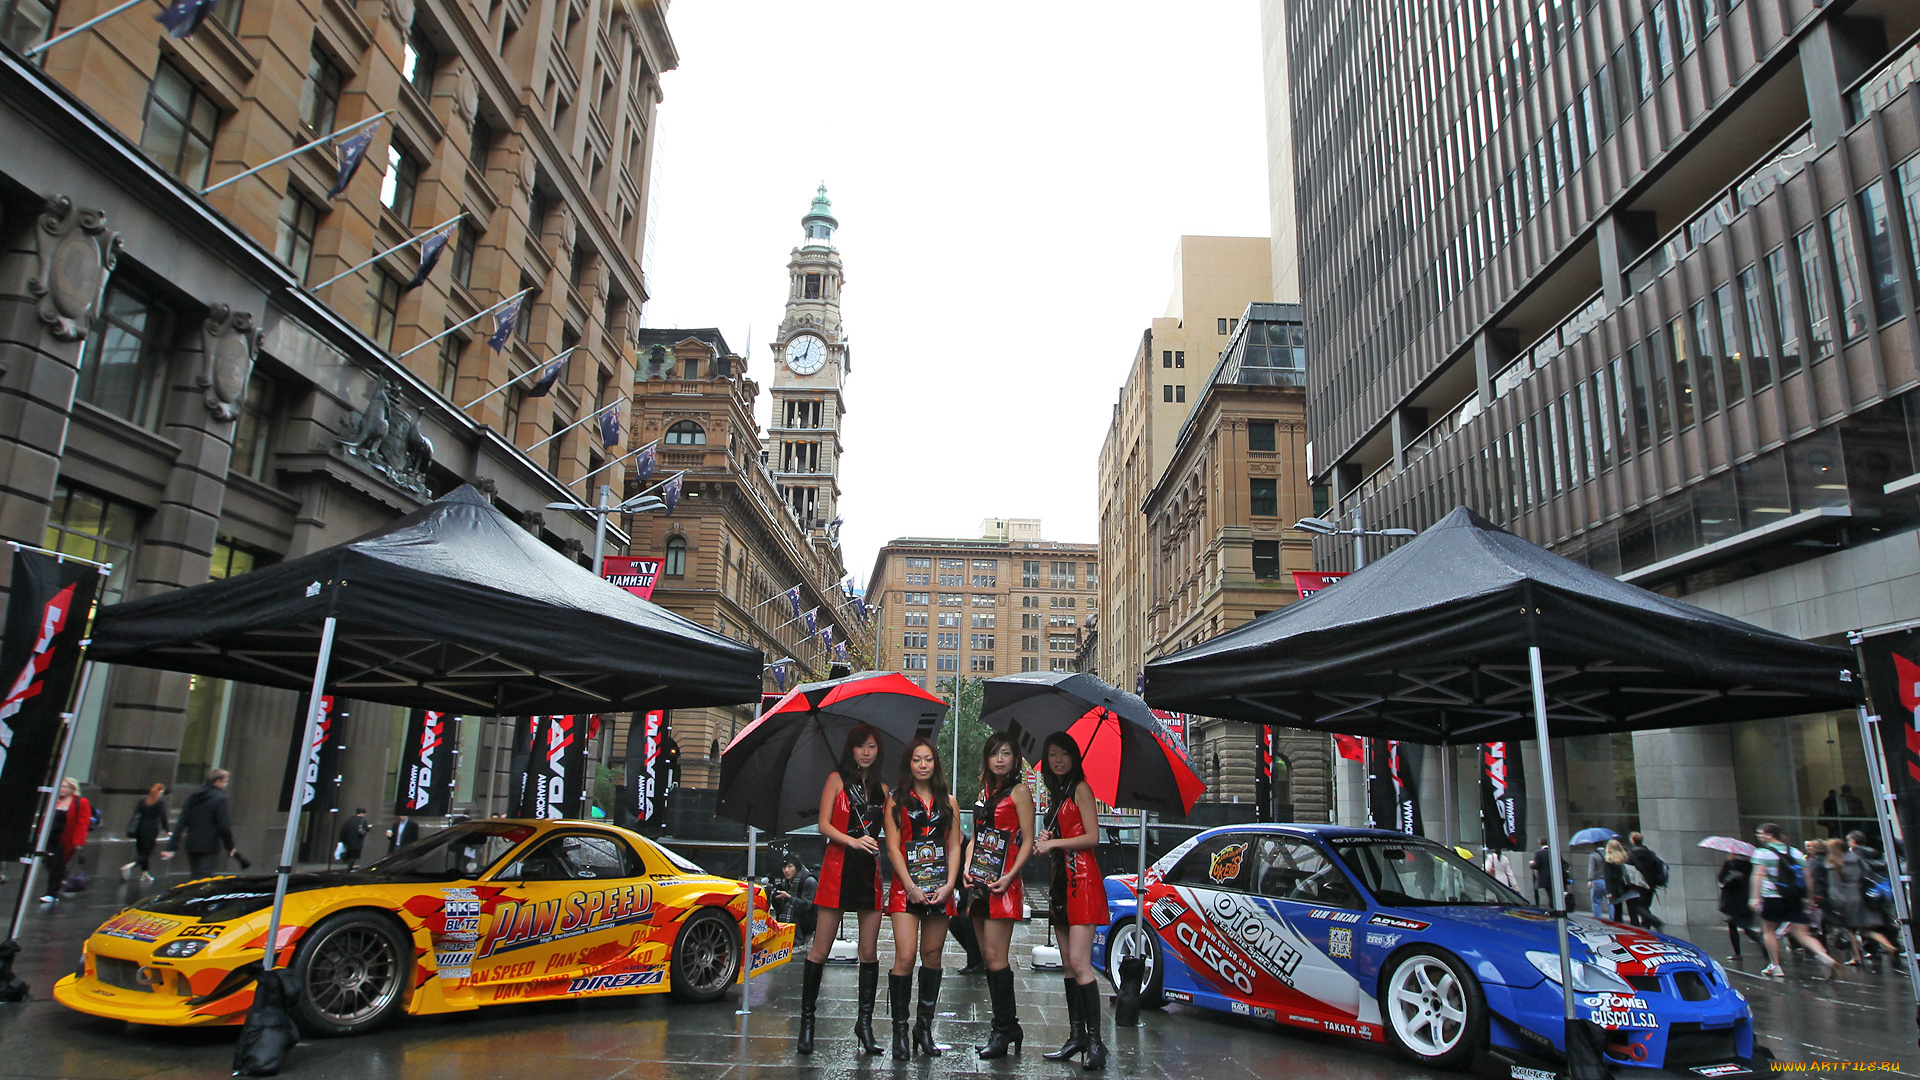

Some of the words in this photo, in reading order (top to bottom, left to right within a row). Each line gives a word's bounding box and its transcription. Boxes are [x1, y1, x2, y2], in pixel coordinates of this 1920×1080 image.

[446, 902, 479, 913] HKS
[476, 898, 563, 960] PAN
[560, 884, 653, 931] SPEED
[1205, 908, 1220, 925] The
[1307, 909, 1331, 920] TEAM
[1329, 912, 1362, 924] TARZAN
[1371, 917, 1420, 929] ADVAN
[587, 922, 616, 933] Technology
[1214, 892, 1303, 978] OTOMEI
[766, 948, 790, 965] GIKEN
[1176, 921, 1254, 996] CUSCO
[567, 970, 666, 993] DIREZZA
[1165, 991, 1191, 1001] ADVAN
[1591, 1010, 1629, 1027] CUSCO
[1631, 1012, 1659, 1028] L.S.D.
[1324, 1021, 1357, 1035] TAKATA
[1510, 1064, 1557, 1080] VOLTEX
